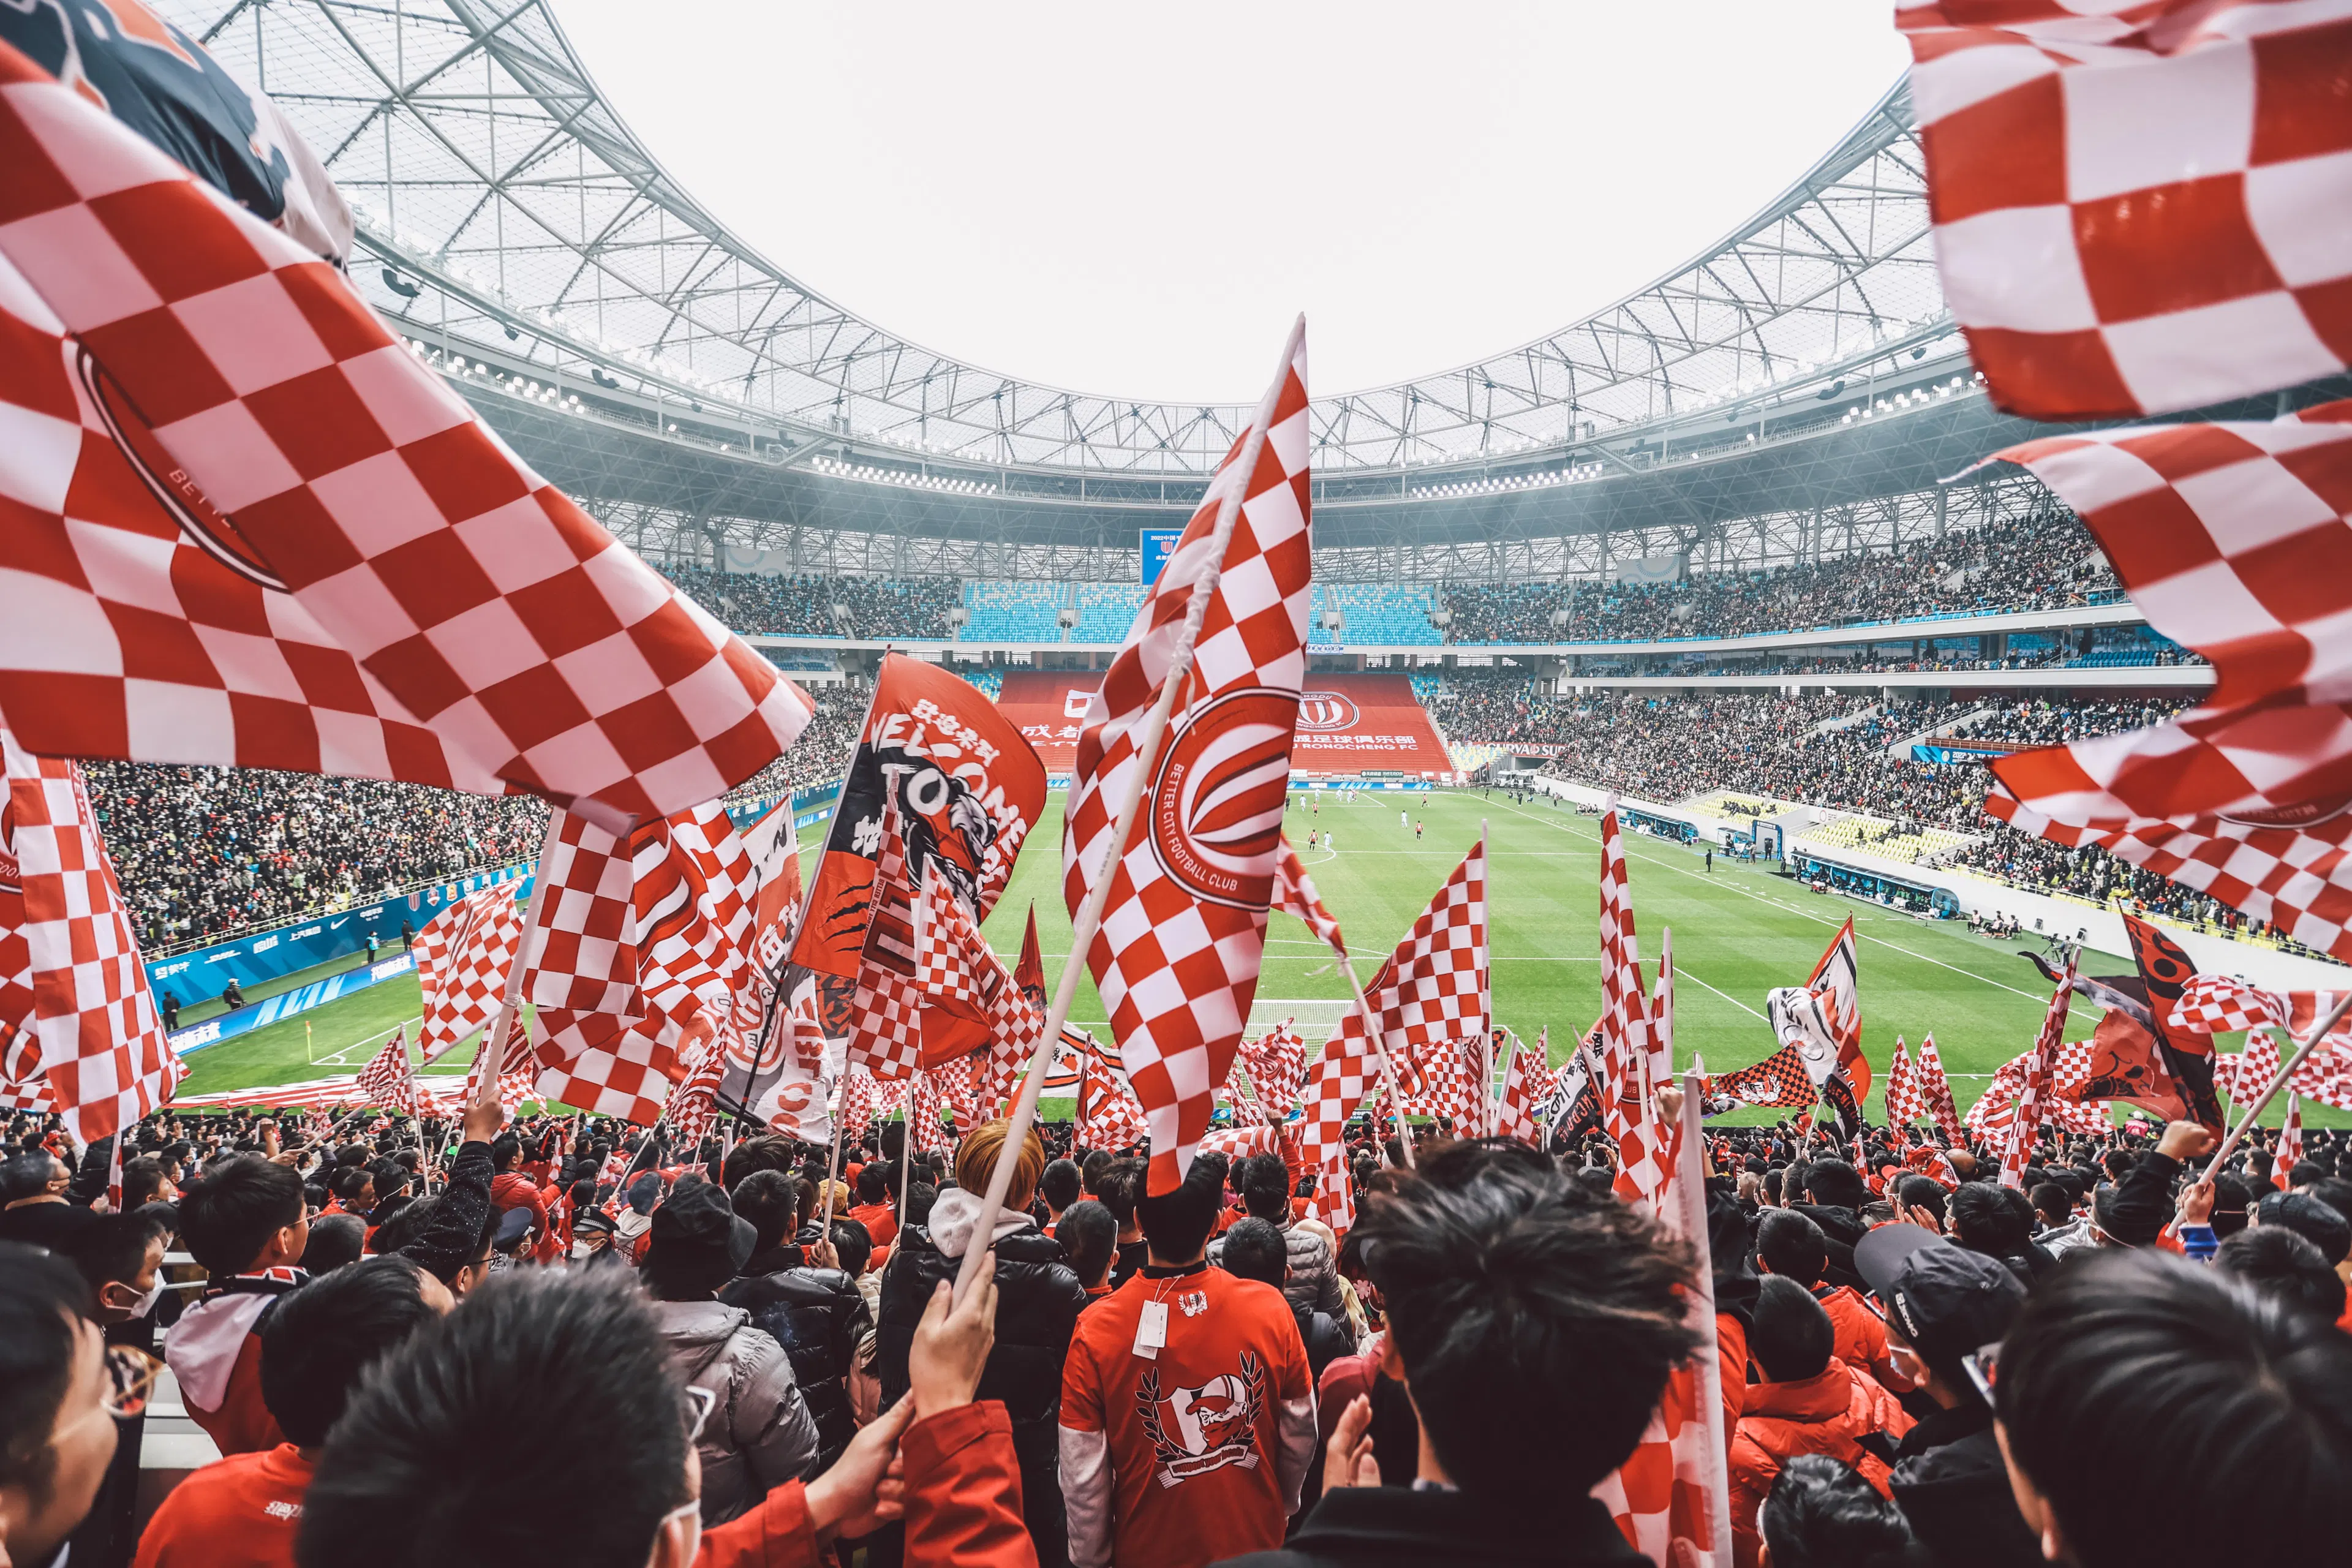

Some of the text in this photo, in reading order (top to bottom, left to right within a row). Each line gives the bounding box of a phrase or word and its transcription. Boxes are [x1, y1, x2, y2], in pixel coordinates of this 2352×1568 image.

[911, 699, 1001, 767] 欢迎来到
[1163, 763, 1238, 892] BETTER CITY FOOTBALL CLUB
[1205, 1453, 1221, 1468] your
